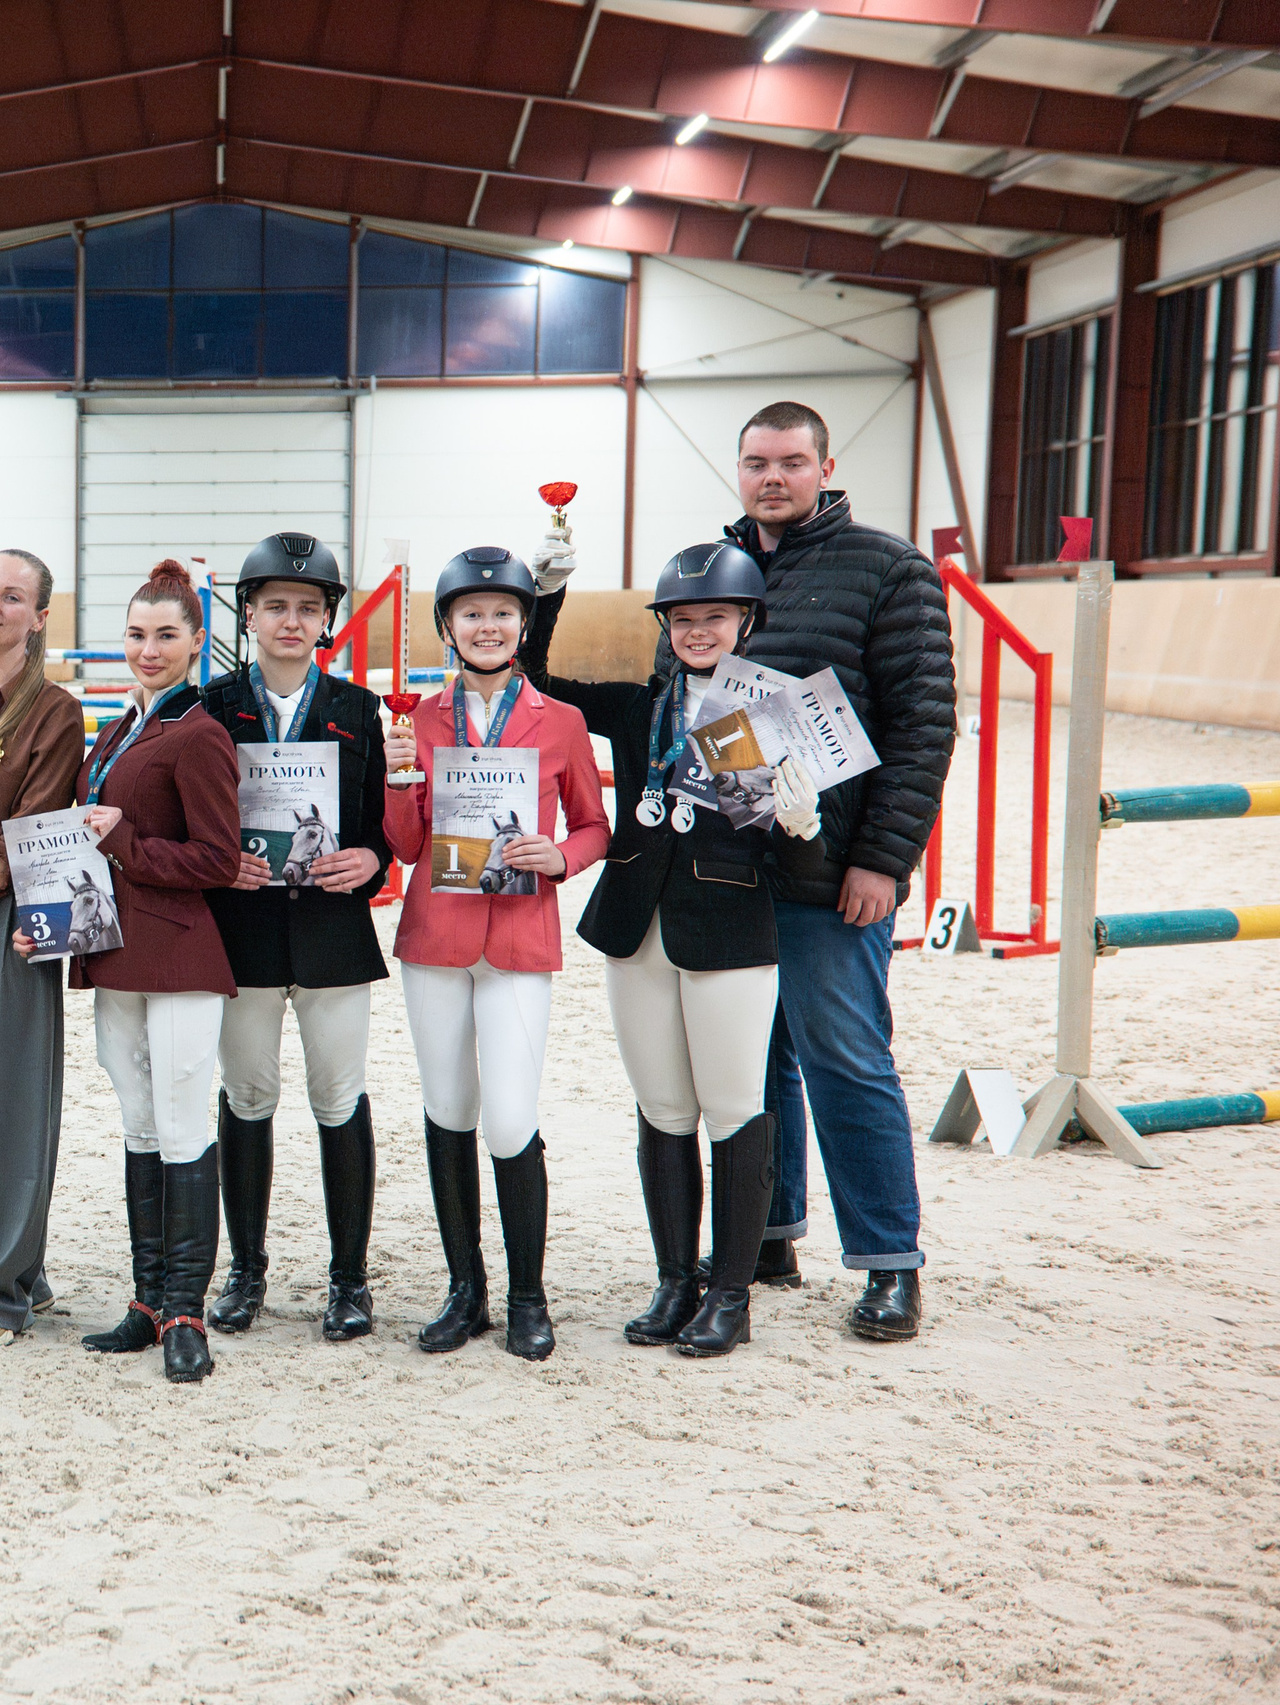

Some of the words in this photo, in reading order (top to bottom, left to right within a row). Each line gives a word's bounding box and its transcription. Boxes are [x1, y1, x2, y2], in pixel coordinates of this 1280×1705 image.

[723, 677, 771, 700] ГРАМ
[713, 726, 746, 752] 1
[801, 691, 849, 769] ГРАМОТА
[703, 735, 720, 761] место
[249, 766, 326, 779] ГРАМОТА
[446, 771, 526, 784] ГРАМОТА
[682, 777, 707, 792] место
[17, 831, 91, 855] ГРАМОТА
[248, 837, 269, 865] 2
[446, 844, 462, 872] 1
[30, 911, 52, 941] 3
[931, 907, 957, 949] 3
